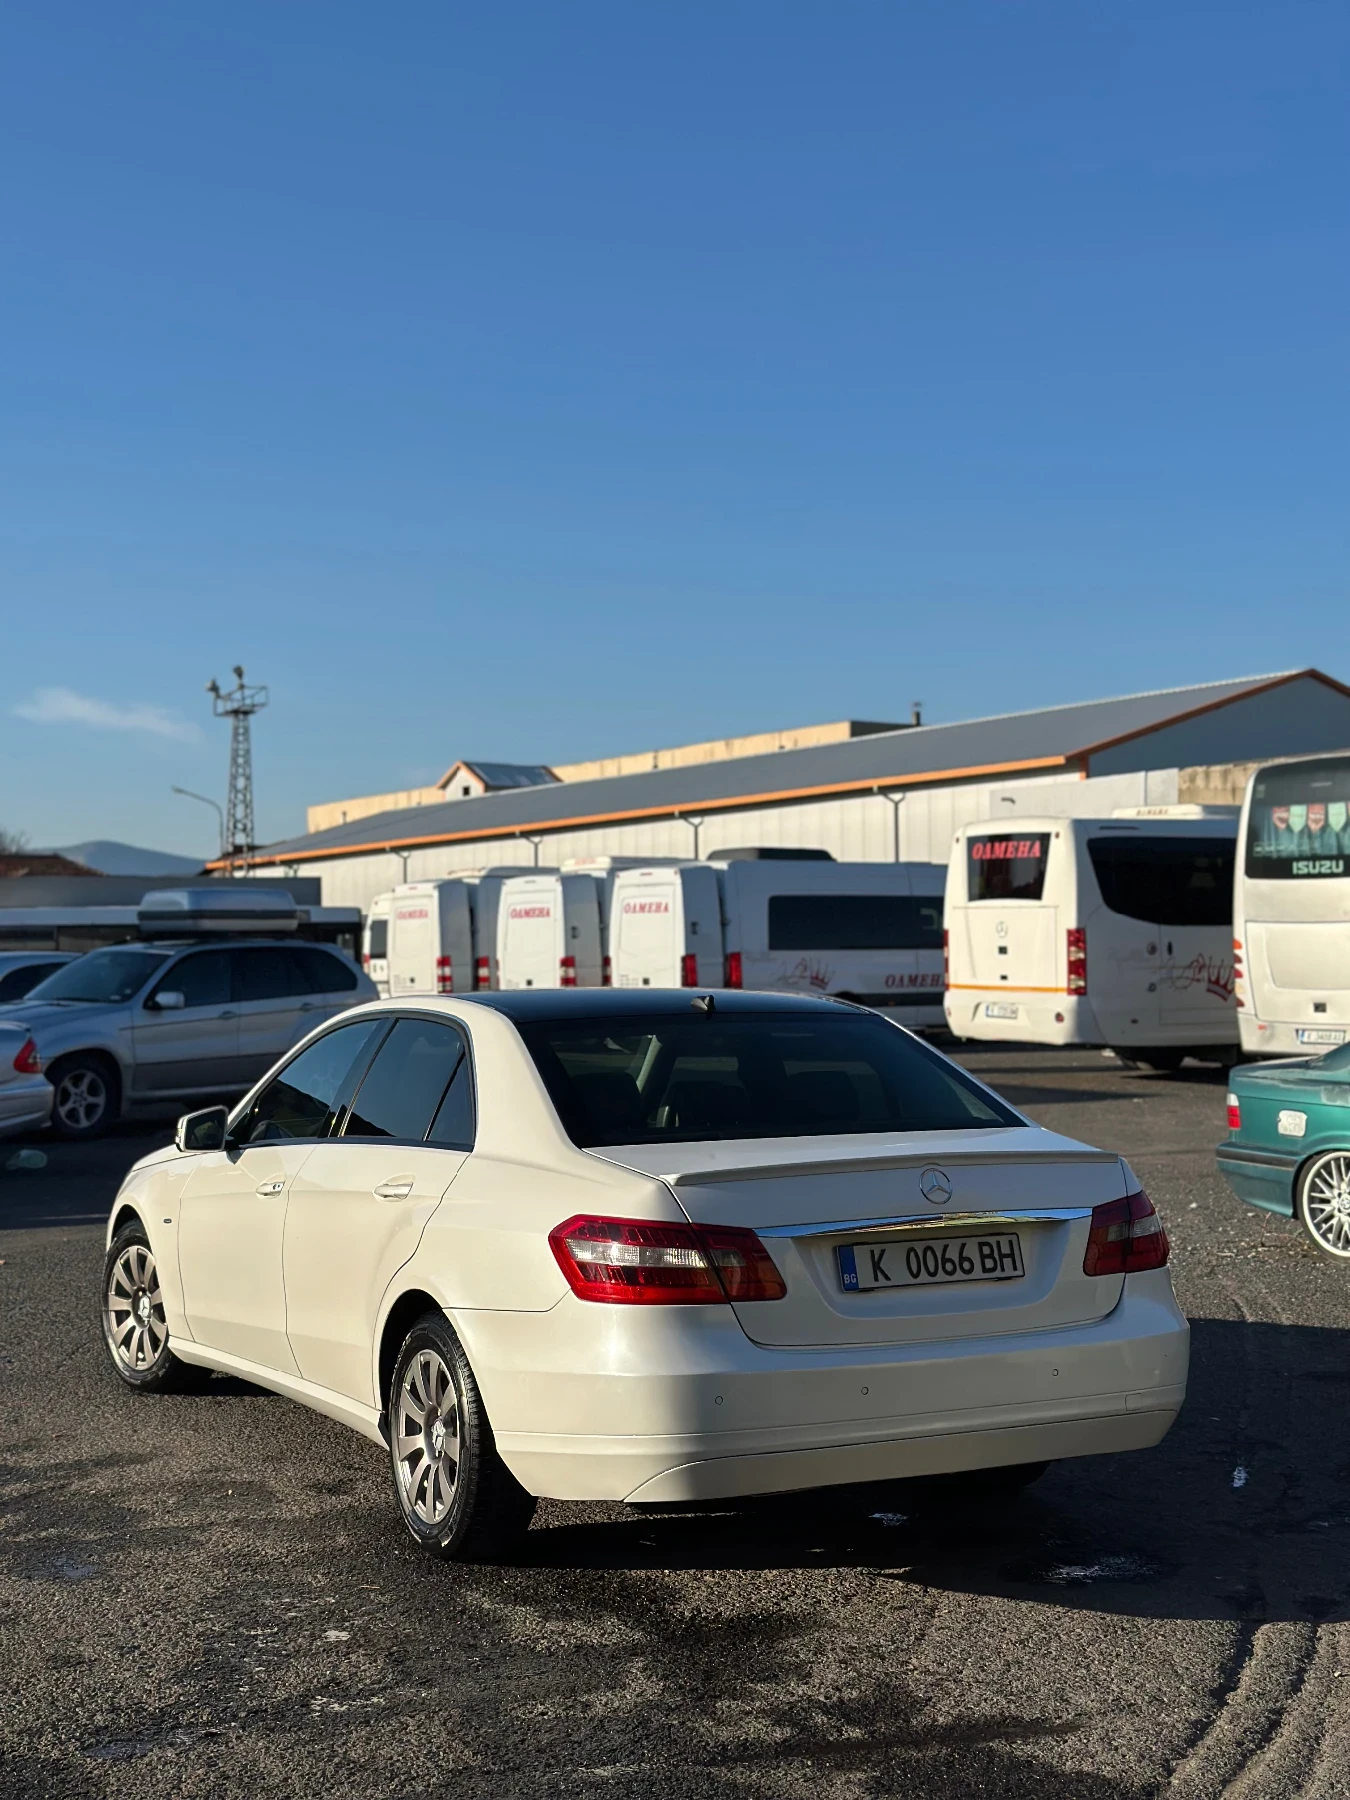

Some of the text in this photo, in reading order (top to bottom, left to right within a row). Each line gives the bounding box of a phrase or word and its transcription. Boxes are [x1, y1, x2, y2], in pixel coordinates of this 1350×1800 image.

[1292, 859, 1344, 875] ISUZU
[869, 1239, 1018, 1282] K 0066 BH
[843, 1273, 857, 1285] BG
